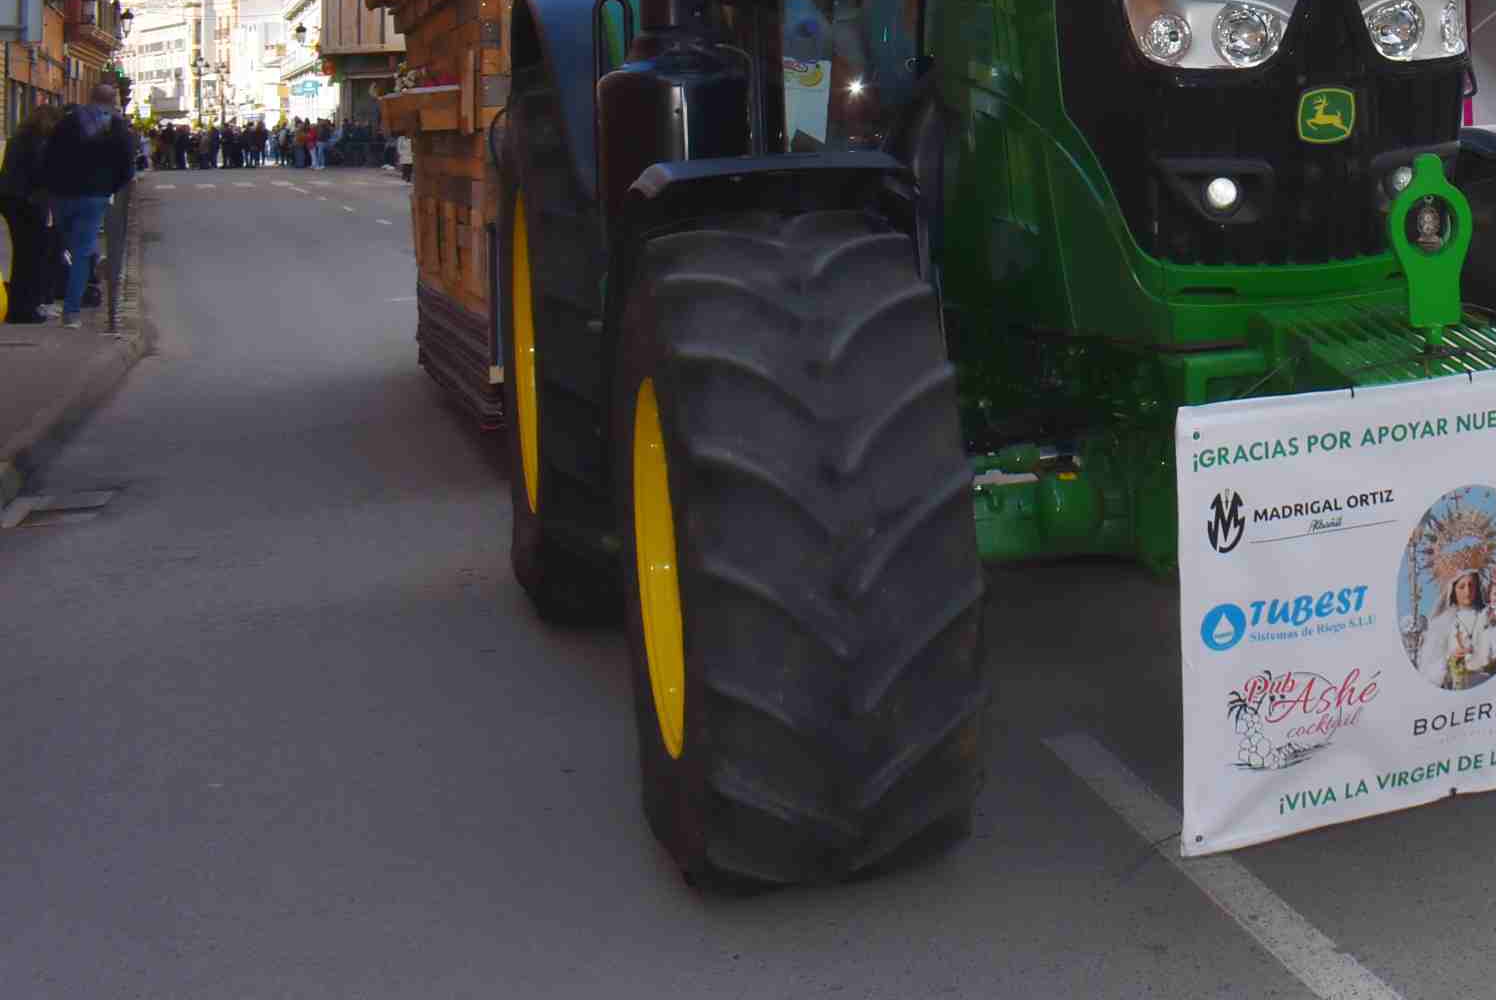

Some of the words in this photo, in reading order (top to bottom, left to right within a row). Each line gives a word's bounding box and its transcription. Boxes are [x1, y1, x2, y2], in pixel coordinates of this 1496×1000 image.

[1193, 437, 1299, 472] ¡GRACIAS
[1307, 430, 1352, 453] POR
[1360, 417, 1448, 447] APOYAR
[1252, 497, 1343, 523] MADRIGAL
[1346, 489, 1395, 509] ORTIZ
[1249, 629, 1299, 642] Sistemas
[1302, 625, 1313, 637] de
[1244, 671, 1296, 702] Pub
[1279, 786, 1337, 814] ¡VIVA
[1344, 779, 1369, 799] LA
[1376, 760, 1451, 790] VIRGEN
[1457, 752, 1484, 772] DE
